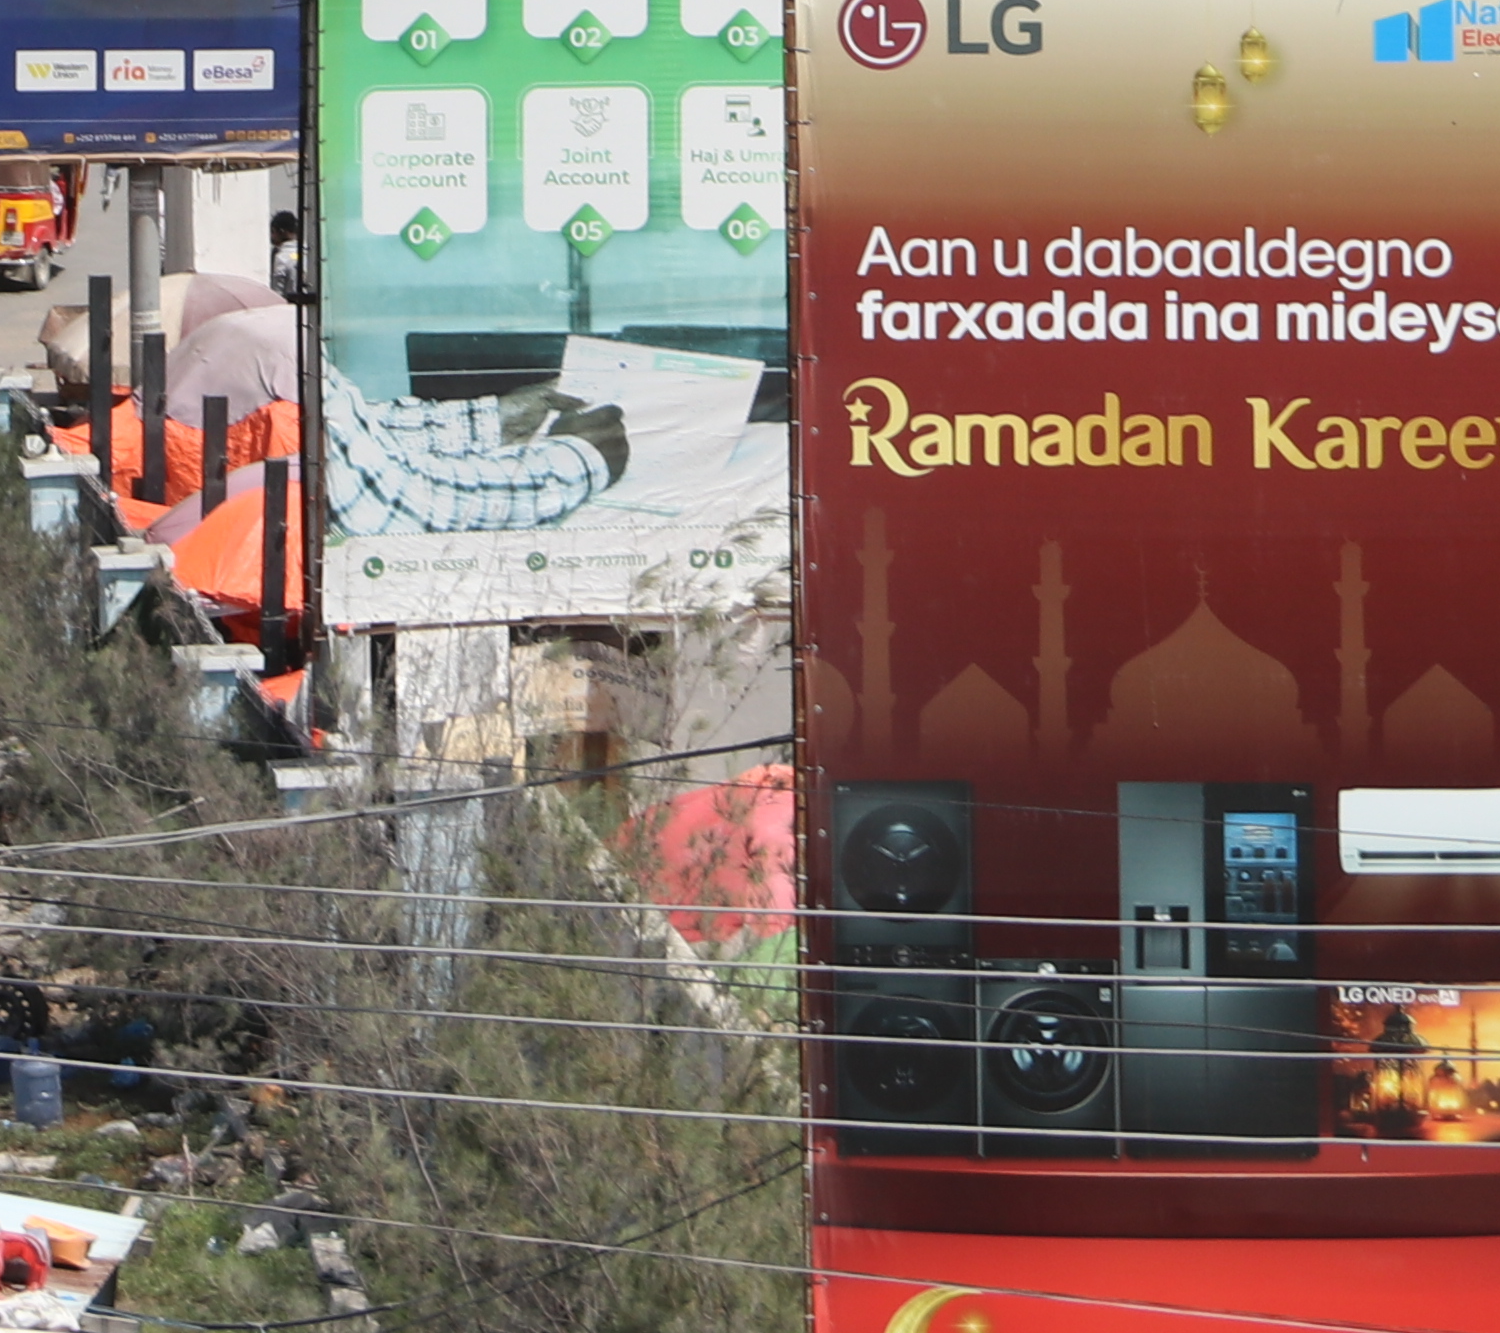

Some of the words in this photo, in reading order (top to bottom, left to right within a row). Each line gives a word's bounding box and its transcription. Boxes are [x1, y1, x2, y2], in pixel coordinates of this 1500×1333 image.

[409, 30, 438, 51] 01
[568, 28, 603, 48] 02
[727, 27, 760, 47] 03
[52, 70, 79, 80] Union
[53, 61, 89, 72] Western
[112, 58, 146, 81] ria
[202, 64, 253, 80] eBesa
[373, 150, 476, 171] Corporate
[560, 147, 613, 165] Joint
[690, 149, 720, 168] Haj
[723, 150, 736, 164] &
[381, 172, 468, 189] Account
[543, 169, 631, 187] Account
[408, 223, 444, 245] 04
[569, 221, 604, 241] 05
[727, 219, 762, 240] 06
[856, 226, 978, 279] Aan
[991, 235, 1028, 278] u
[1044, 225, 1453, 290] dabaaldegno
[856, 289, 1149, 341] farxadda
[1164, 290, 1256, 341] ina
[841, 376, 1213, 477] Ramadan
[1338, 986, 1364, 1004] LG
[1365, 986, 1417, 1005] QNED
